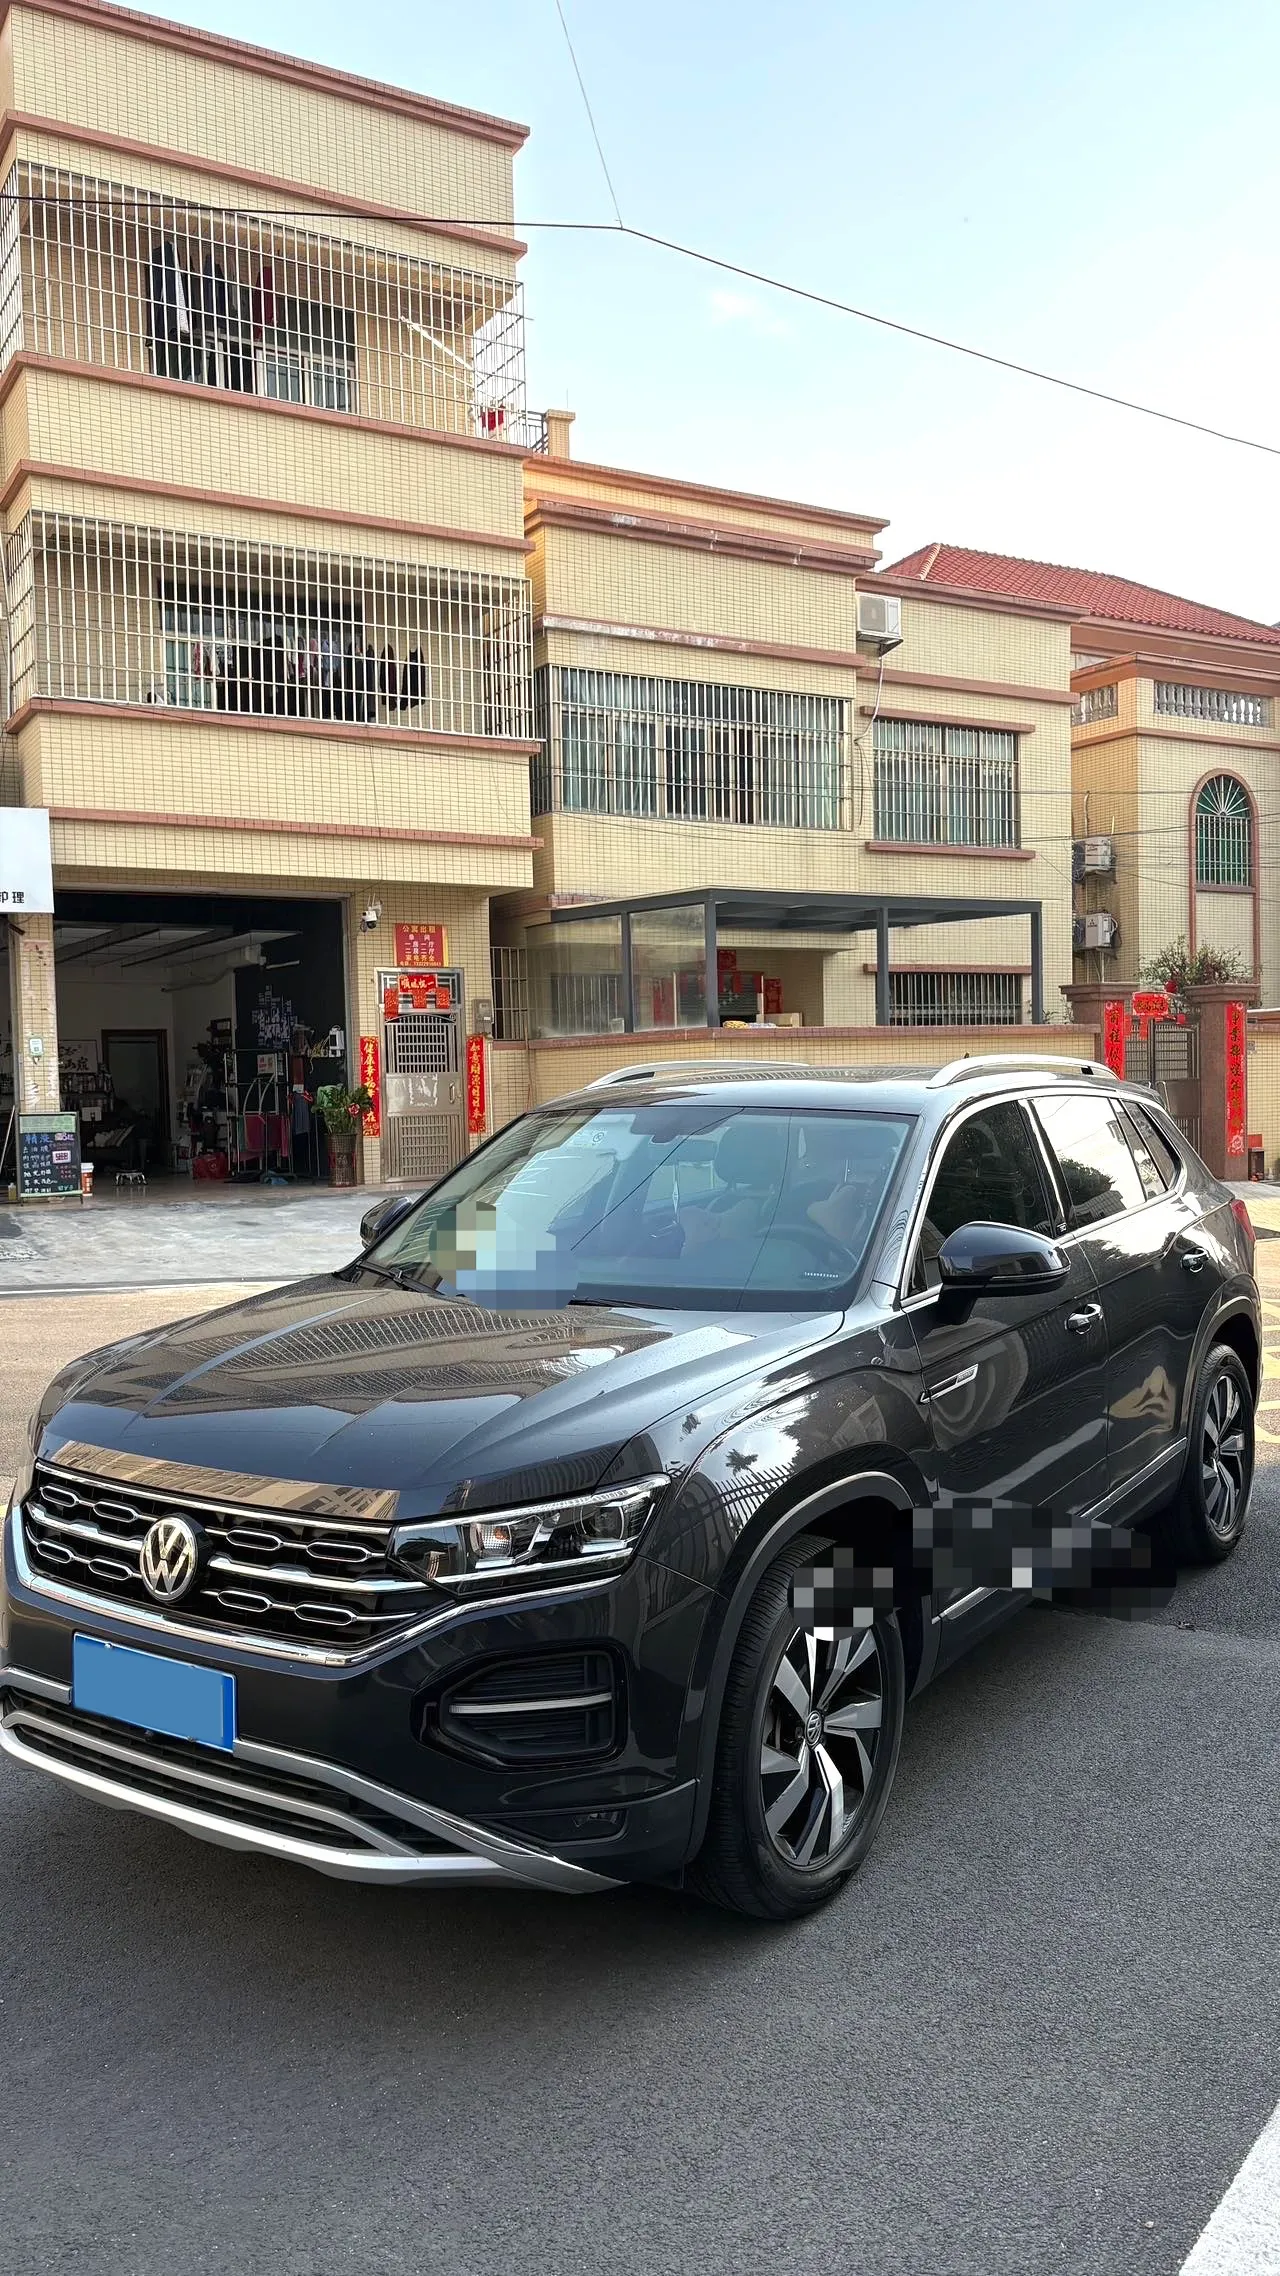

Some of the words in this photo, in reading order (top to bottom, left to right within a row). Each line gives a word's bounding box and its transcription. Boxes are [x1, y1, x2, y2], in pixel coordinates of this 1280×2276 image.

[364, 1042, 376, 1122] 健康幸福年在
